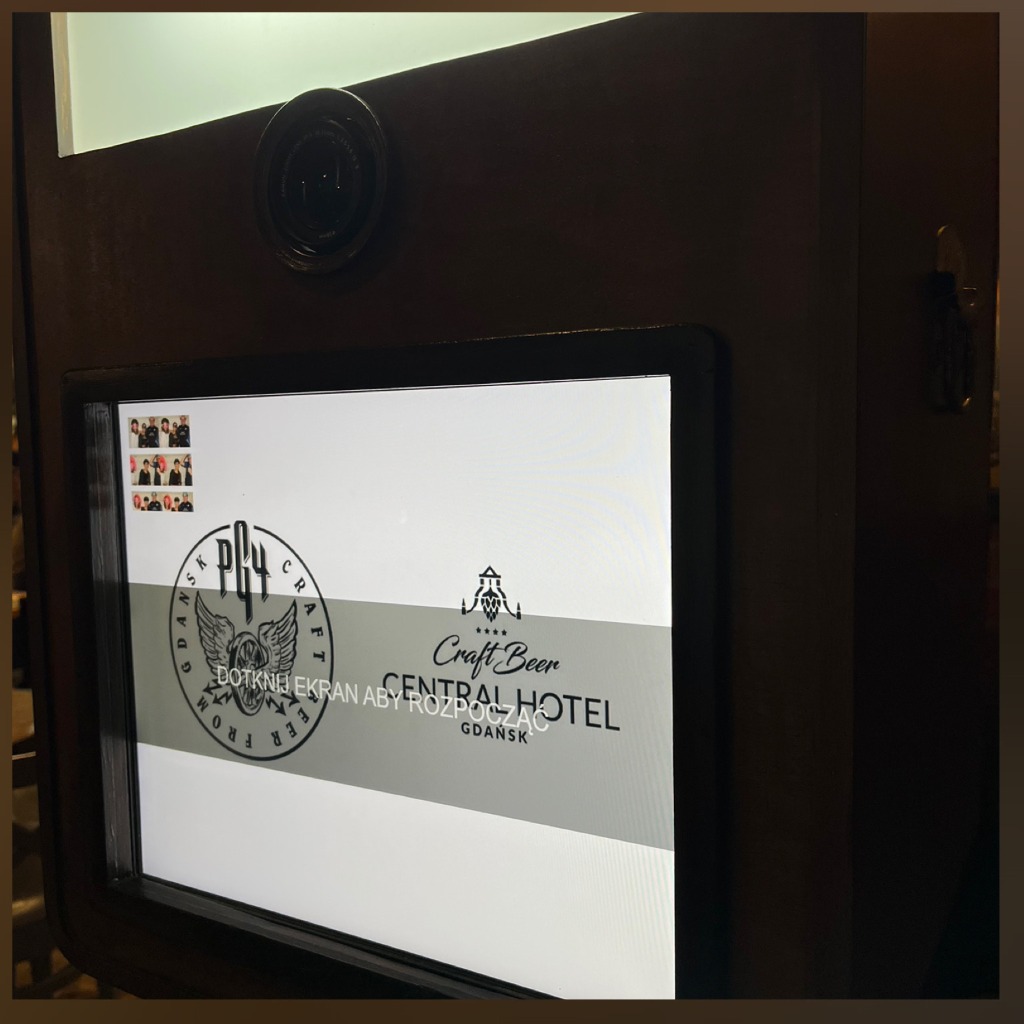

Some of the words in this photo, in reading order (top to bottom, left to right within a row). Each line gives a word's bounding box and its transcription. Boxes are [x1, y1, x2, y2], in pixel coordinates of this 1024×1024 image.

[282, 559, 326, 663] CRAFT
[433, 634, 502, 680] Craft
[493, 641, 561, 675] Beer
[196, 696, 253, 749] FROM
[217, 665, 290, 694] DOTKNIJ
[295, 676, 358, 705] EKRAN
[363, 685, 404, 711] ABY
[409, 691, 549, 736] ROZPOCZĄĆ
[382, 672, 508, 715] CENTRAL
[517, 688, 621, 732] HOTEL
[461, 721, 528, 744] GDAŃSK
